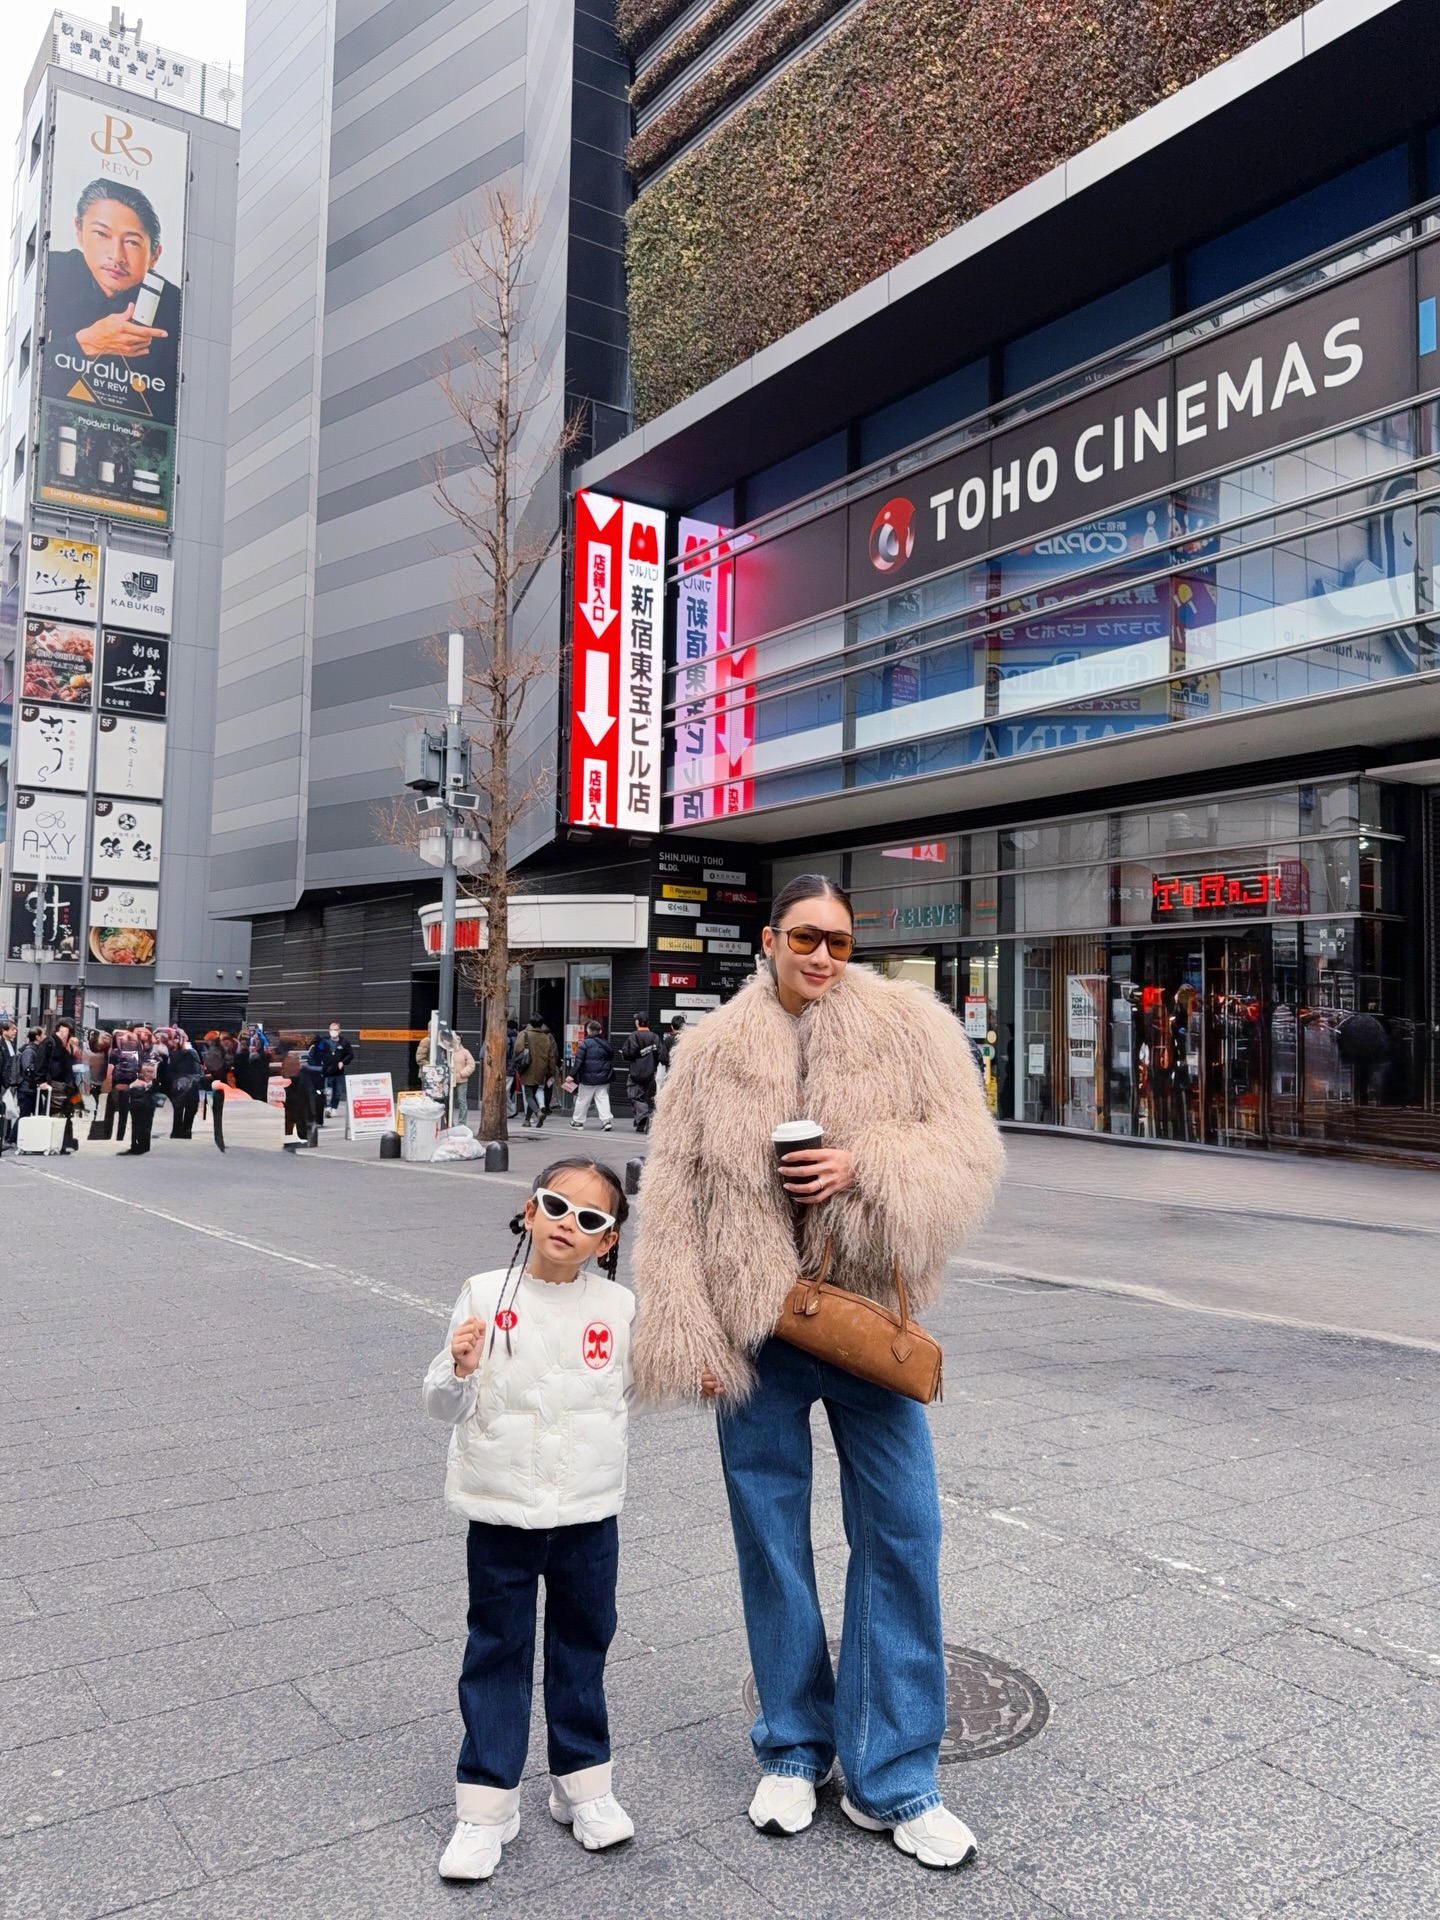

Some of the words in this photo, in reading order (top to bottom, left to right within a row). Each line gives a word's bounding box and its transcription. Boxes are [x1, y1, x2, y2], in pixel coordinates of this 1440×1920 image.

[100, 158, 139, 180] REVI
[55, 353, 166, 392] auralume
[93, 378, 105, 388] BY
[107, 381, 128, 394] REVI
[78, 416, 111, 431] Product
[112, 425, 140, 437] Lineup
[930, 445, 1058, 542] TOHO
[1073, 317, 1364, 484] CINEMAS
[50, 488, 73, 499] Luxury
[74, 492, 102, 505] Organic
[104, 499, 138, 512] Cosmetics
[139, 505, 158, 516] Series
[33, 537, 44, 547] 8F
[628, 563, 659, 582] マルハン
[593, 554, 605, 622] 店舗入口
[111, 598, 165, 616] KABUKI町
[28, 623, 40, 632] 6F
[106, 635, 117, 644] 7F
[132, 642, 160, 661] 別邸
[627, 584, 654, 815] 新宿東宝ビル店
[23, 709, 35, 718] 4F
[102, 719, 113, 728] 5F
[19, 796, 30, 805] 2F
[98, 803, 109, 811] 3F
[23, 829, 77, 855] AXY
[659, 852, 700, 864] SHINJUKU
[702, 856, 724, 866] TOHO
[659, 862, 679, 872] BLDG.
[15, 884, 26, 893] B1
[94, 888, 105, 898] 1F
[1153, 874, 1281, 910] TORAJI
[1320, 928, 1345, 939] 焼肉
[1320, 941, 1347, 952] トラジ
[671, 976, 689, 985] KFC
